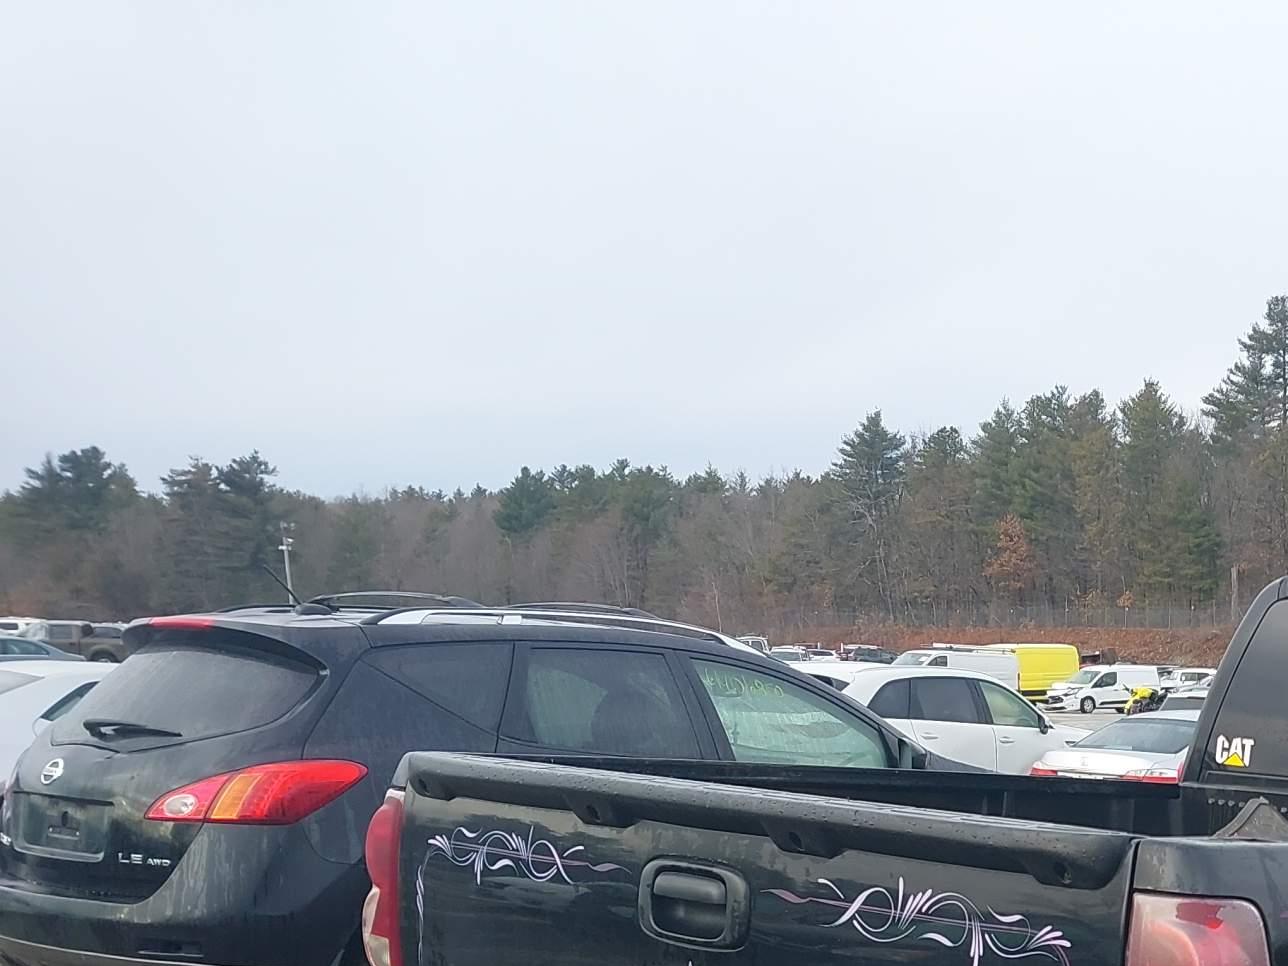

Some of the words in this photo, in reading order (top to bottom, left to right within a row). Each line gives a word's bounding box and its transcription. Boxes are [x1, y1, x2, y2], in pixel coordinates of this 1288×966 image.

[1215, 734, 1255, 767] CAT
[118, 852, 143, 864] LE
[146, 858, 171, 867] AWD
